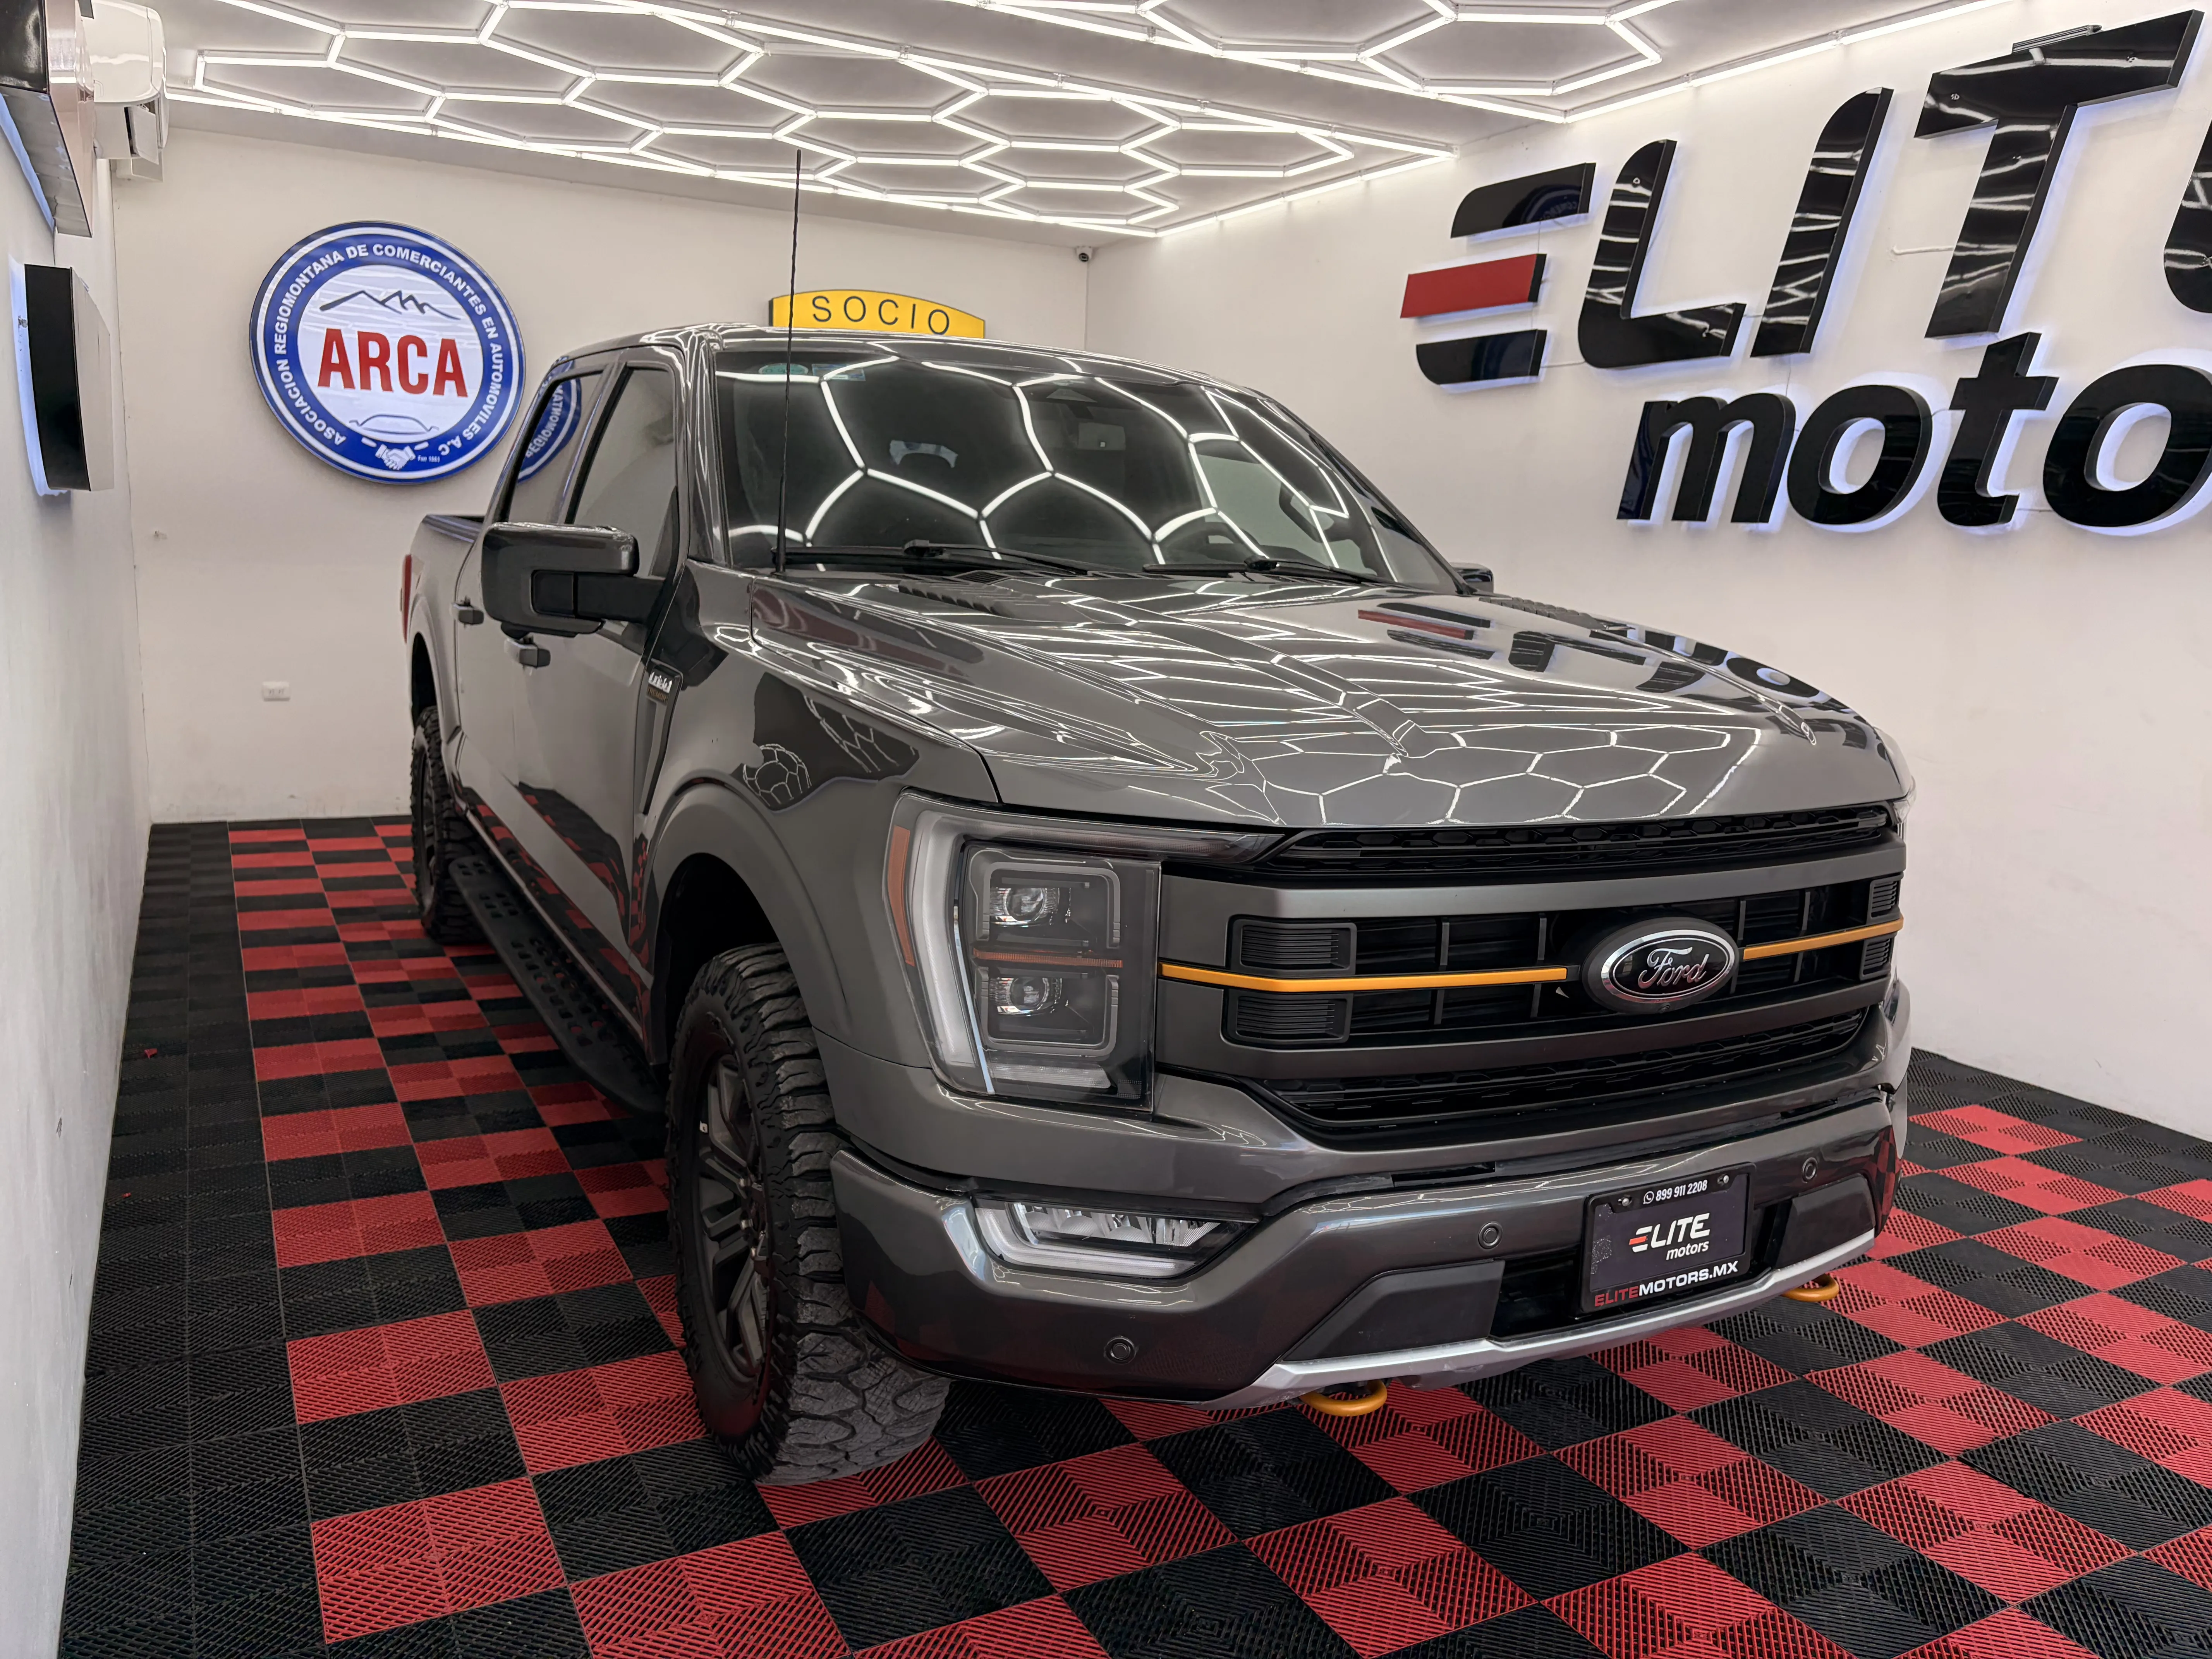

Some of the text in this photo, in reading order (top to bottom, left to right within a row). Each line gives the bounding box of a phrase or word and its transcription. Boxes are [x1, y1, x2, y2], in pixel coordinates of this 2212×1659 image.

[345, 244, 369, 259] DE
[373, 244, 486, 315] COMERCIANTES
[274, 251, 345, 354] REGIOMONTANA
[812, 296, 950, 335] SOCIO
[481, 317, 499, 339] EN
[317, 328, 468, 398] ARCA
[276, 359, 347, 445] ASOCIACION
[462, 342, 503, 440] AUTOMOVILES
[1637, 946, 1710, 989] Ford
[1656, 1180, 1708, 1201] 899 911 2208
[1629, 1212, 1711, 1253] ELITE
[1666, 1241, 1710, 1261] motors
[1594, 1261, 1738, 1307] ELITEMOTORS.MX
